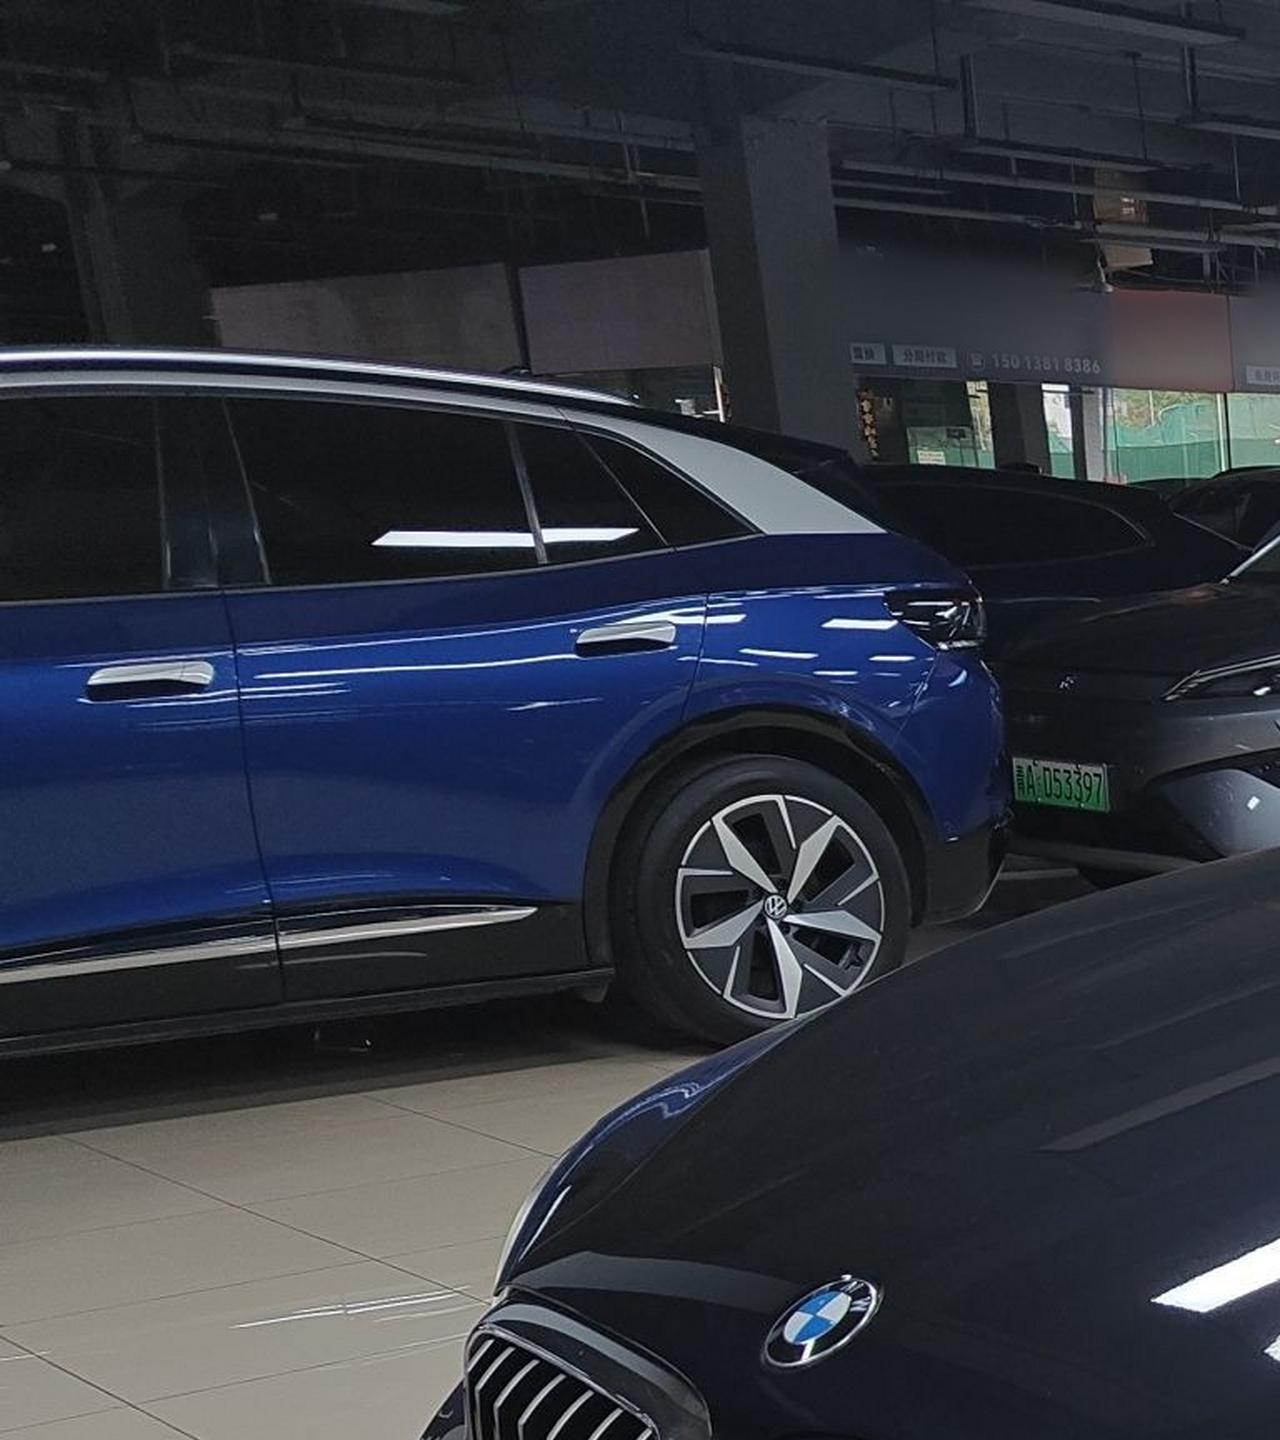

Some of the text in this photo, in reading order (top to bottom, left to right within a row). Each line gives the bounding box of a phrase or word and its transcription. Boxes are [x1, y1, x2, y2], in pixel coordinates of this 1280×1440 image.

[991, 352, 1020, 369] 150
[1024, 354, 1060, 372] 1381
[1064, 356, 1101, 374] 8386
